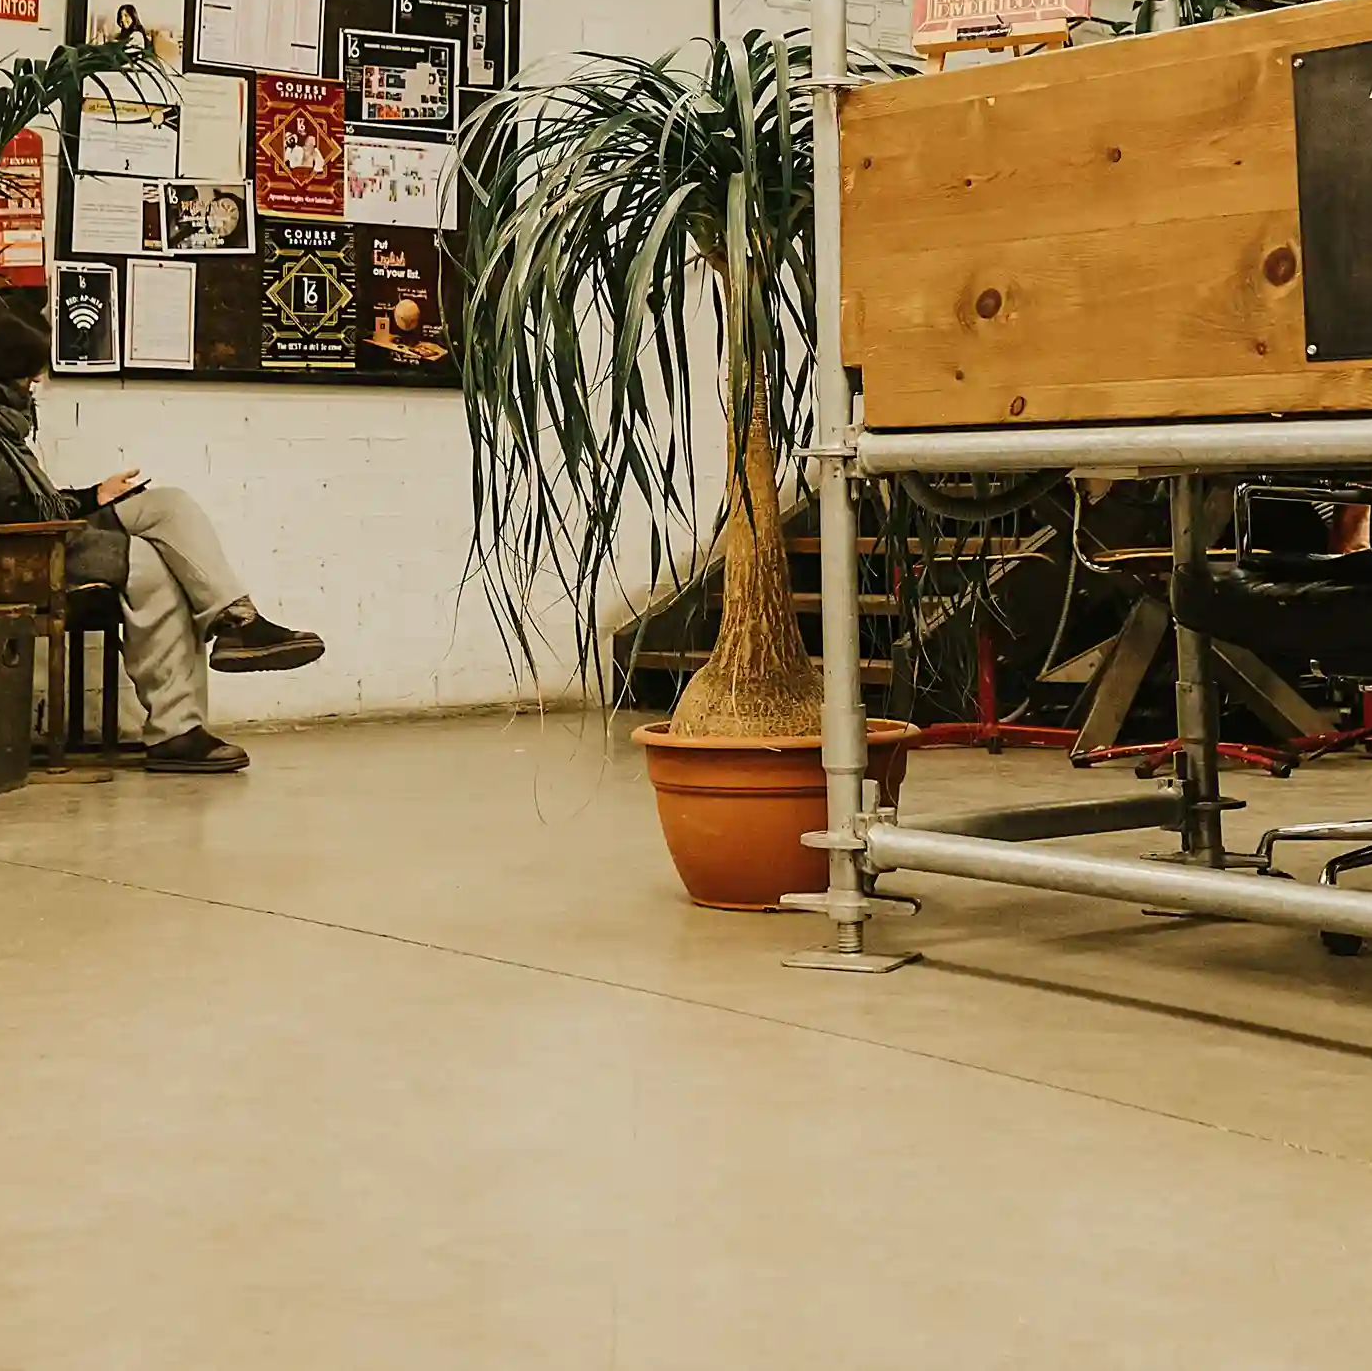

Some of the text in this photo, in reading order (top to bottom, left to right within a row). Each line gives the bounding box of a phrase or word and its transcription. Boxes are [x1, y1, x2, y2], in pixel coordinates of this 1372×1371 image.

[346, 33, 360, 58] 16
[275, 81, 327, 96] COURSE
[167, 186, 178, 205] 16
[284, 229, 337, 241] COURSE
[373, 239, 388, 249] Put
[373, 249, 406, 268] English
[372, 268, 421, 279] on your list.
[302, 277, 318, 305] 16
